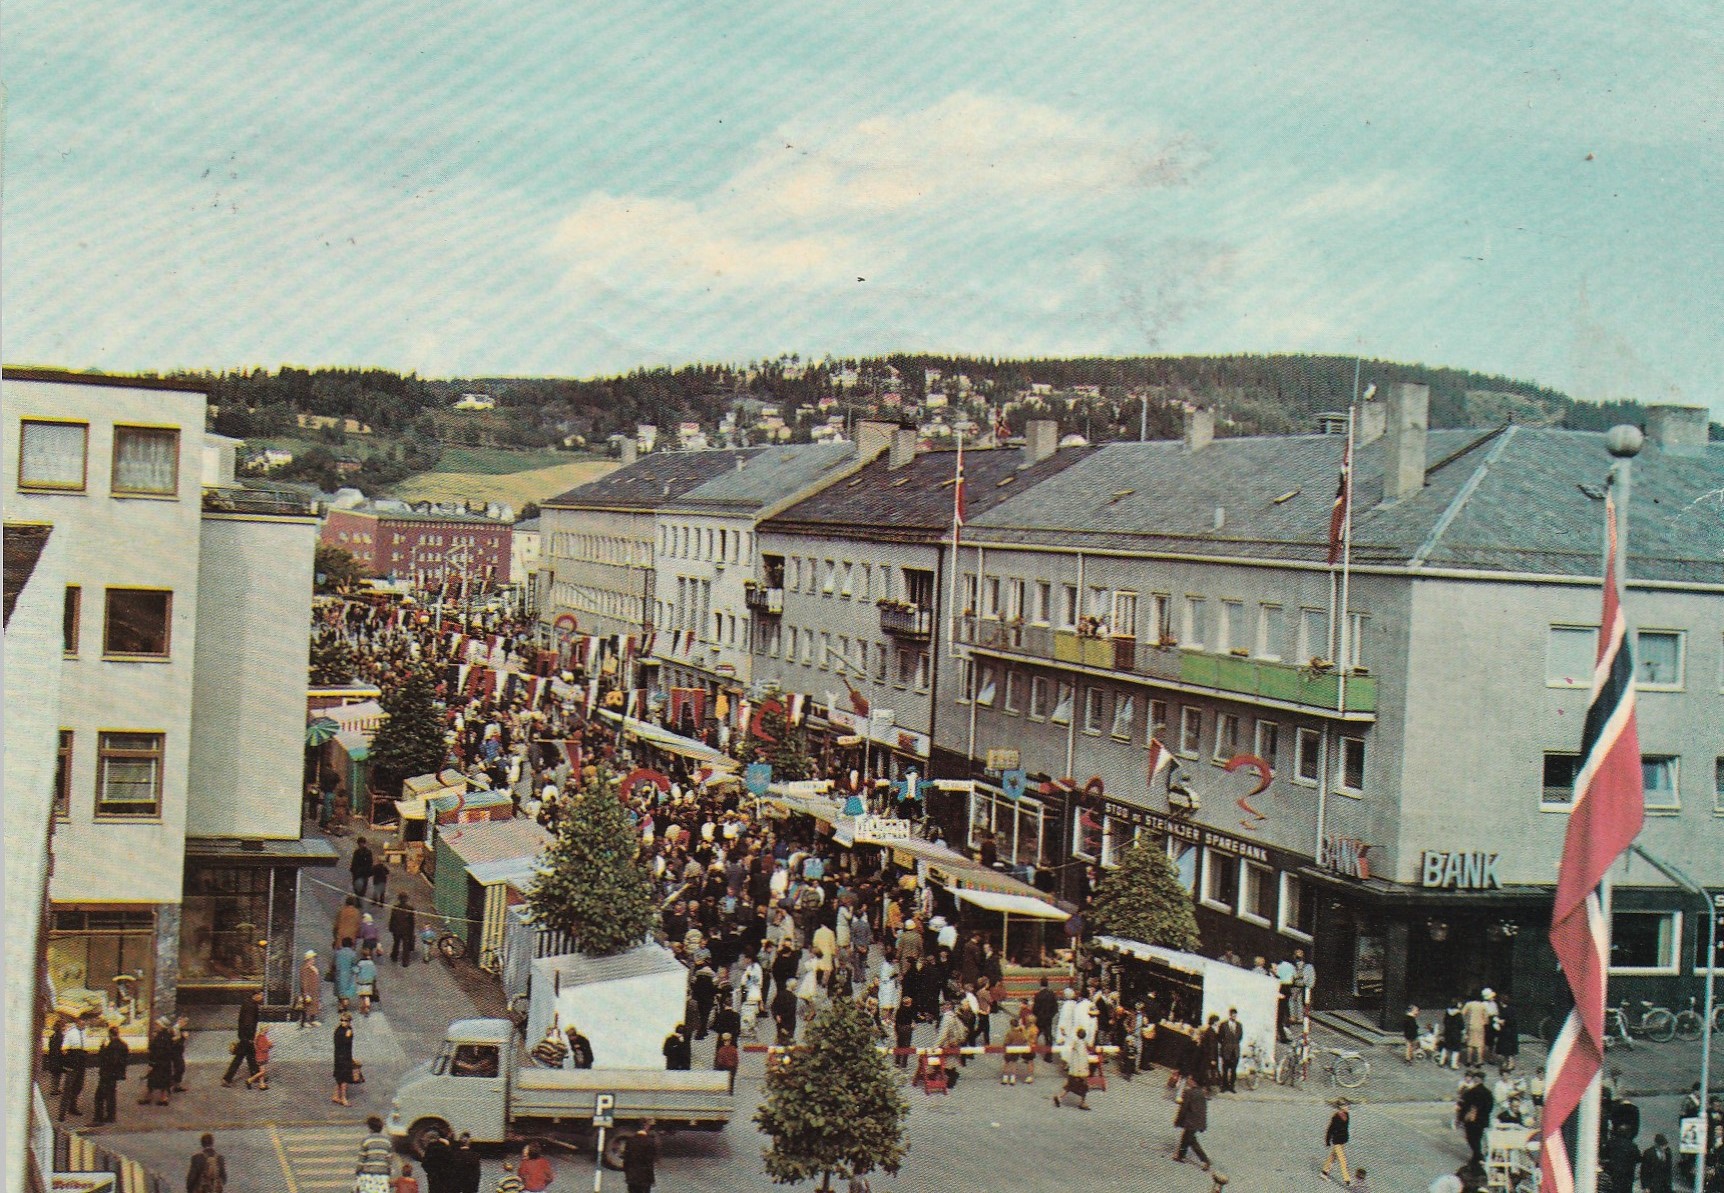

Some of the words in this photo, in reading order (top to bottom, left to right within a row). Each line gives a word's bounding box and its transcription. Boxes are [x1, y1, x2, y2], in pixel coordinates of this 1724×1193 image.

[1205, 831, 1268, 862] SPAREBANK
[1318, 834, 1371, 879] BANK
[1420, 849, 1503, 889] BANK
[595, 1094, 614, 1116] P
